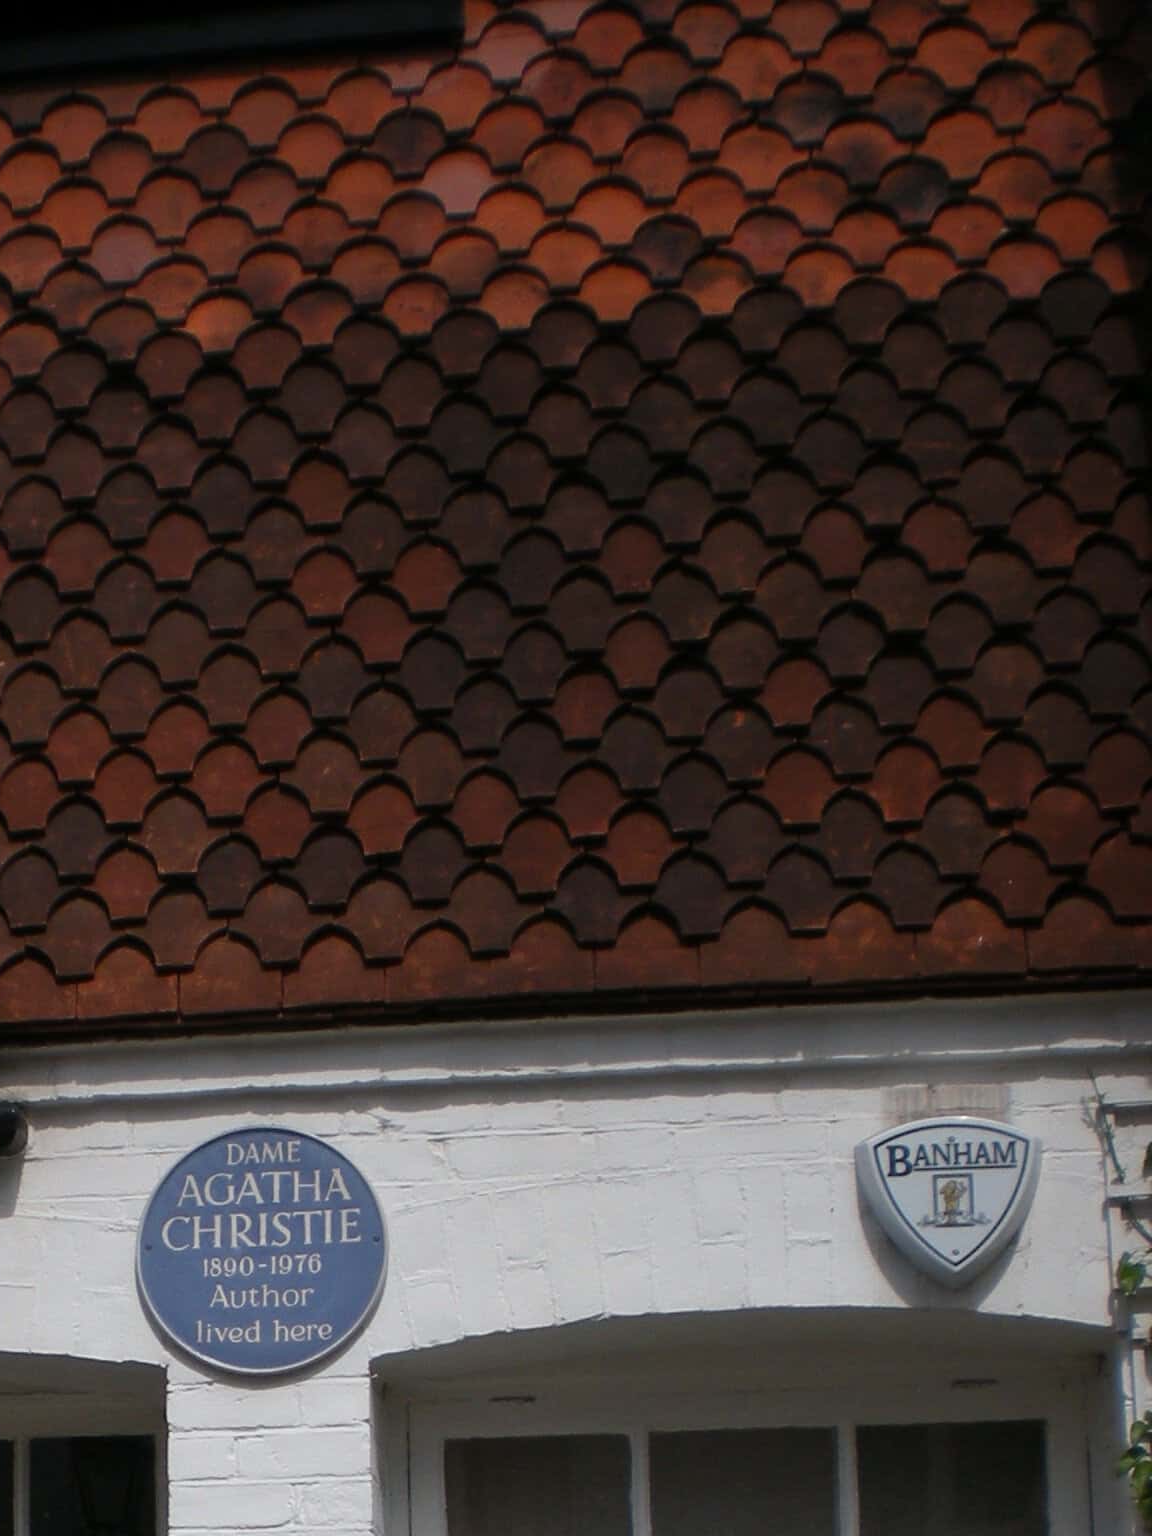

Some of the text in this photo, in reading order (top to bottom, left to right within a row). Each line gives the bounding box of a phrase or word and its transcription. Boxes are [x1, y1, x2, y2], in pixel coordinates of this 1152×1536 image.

[227, 1140, 301, 1166] DAME
[886, 1140, 1018, 1177] BANHAM
[177, 1168, 352, 1207] AGATHA
[161, 1208, 362, 1251] CHRISTIE
[203, 1254, 321, 1278] 1890-1976
[209, 1284, 315, 1309] Author
[197, 1319, 333, 1343] lived here
